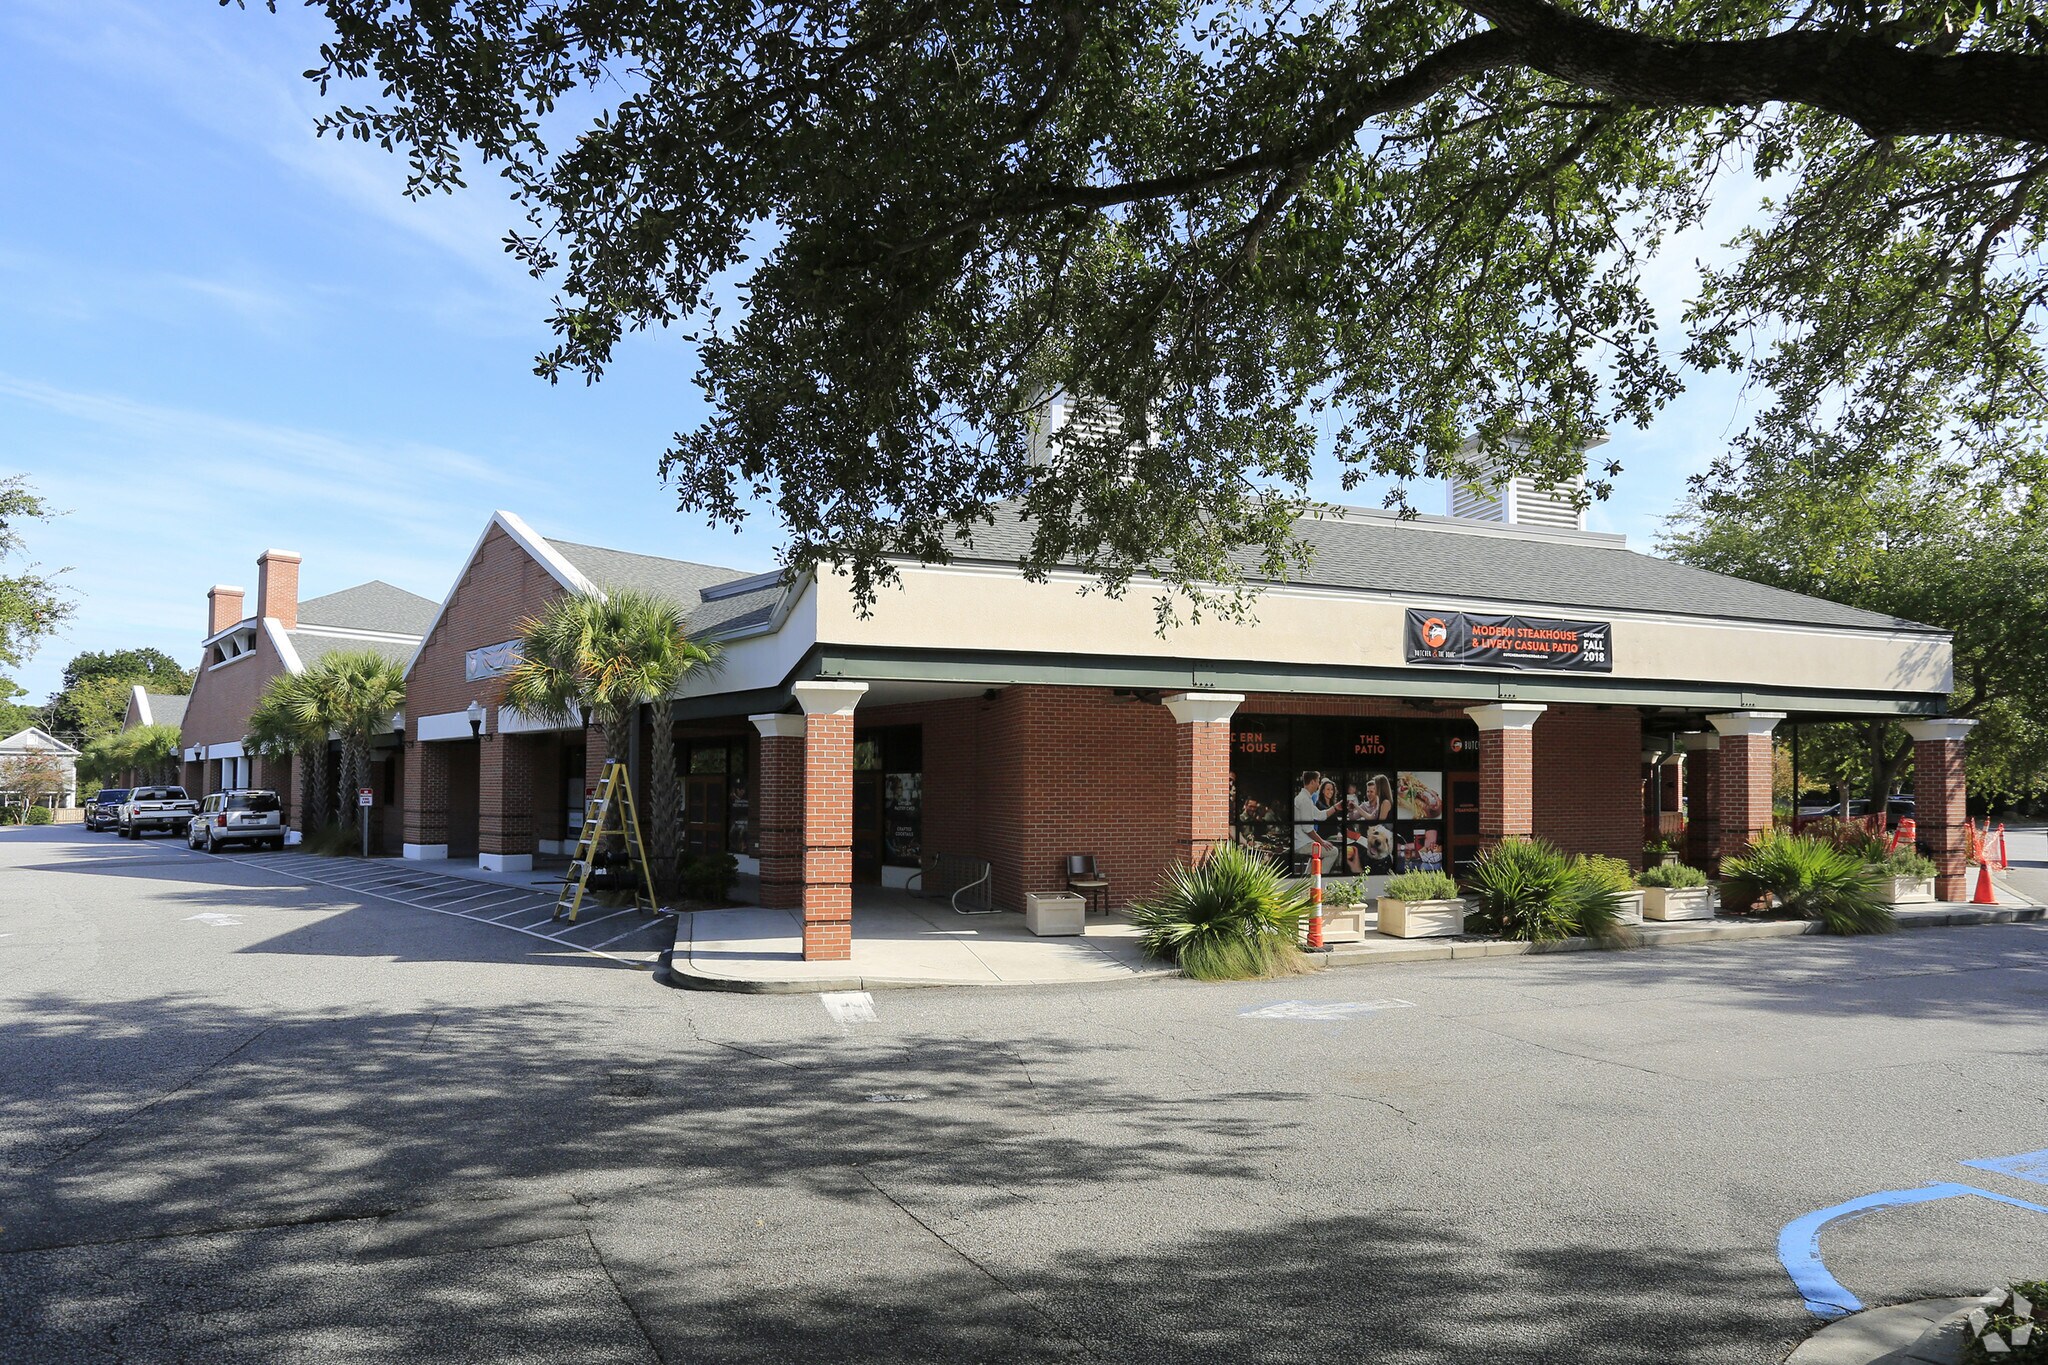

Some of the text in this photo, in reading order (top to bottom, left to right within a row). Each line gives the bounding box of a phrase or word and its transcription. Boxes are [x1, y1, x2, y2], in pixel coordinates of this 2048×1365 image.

[1472, 625, 1577, 641] MODERN STEAKHOUSE
[1472, 637, 1579, 653] & LIVELY CASUAL PATIO
[1583, 640, 1604, 650] FALL
[1583, 651, 1605, 662] 2018
[1360, 734, 1380, 744] THE
[1230, 743, 1277, 753] HOUSE
[1355, 744, 1386, 754] PATIO
[1464, 740, 1480, 750] BUTC
